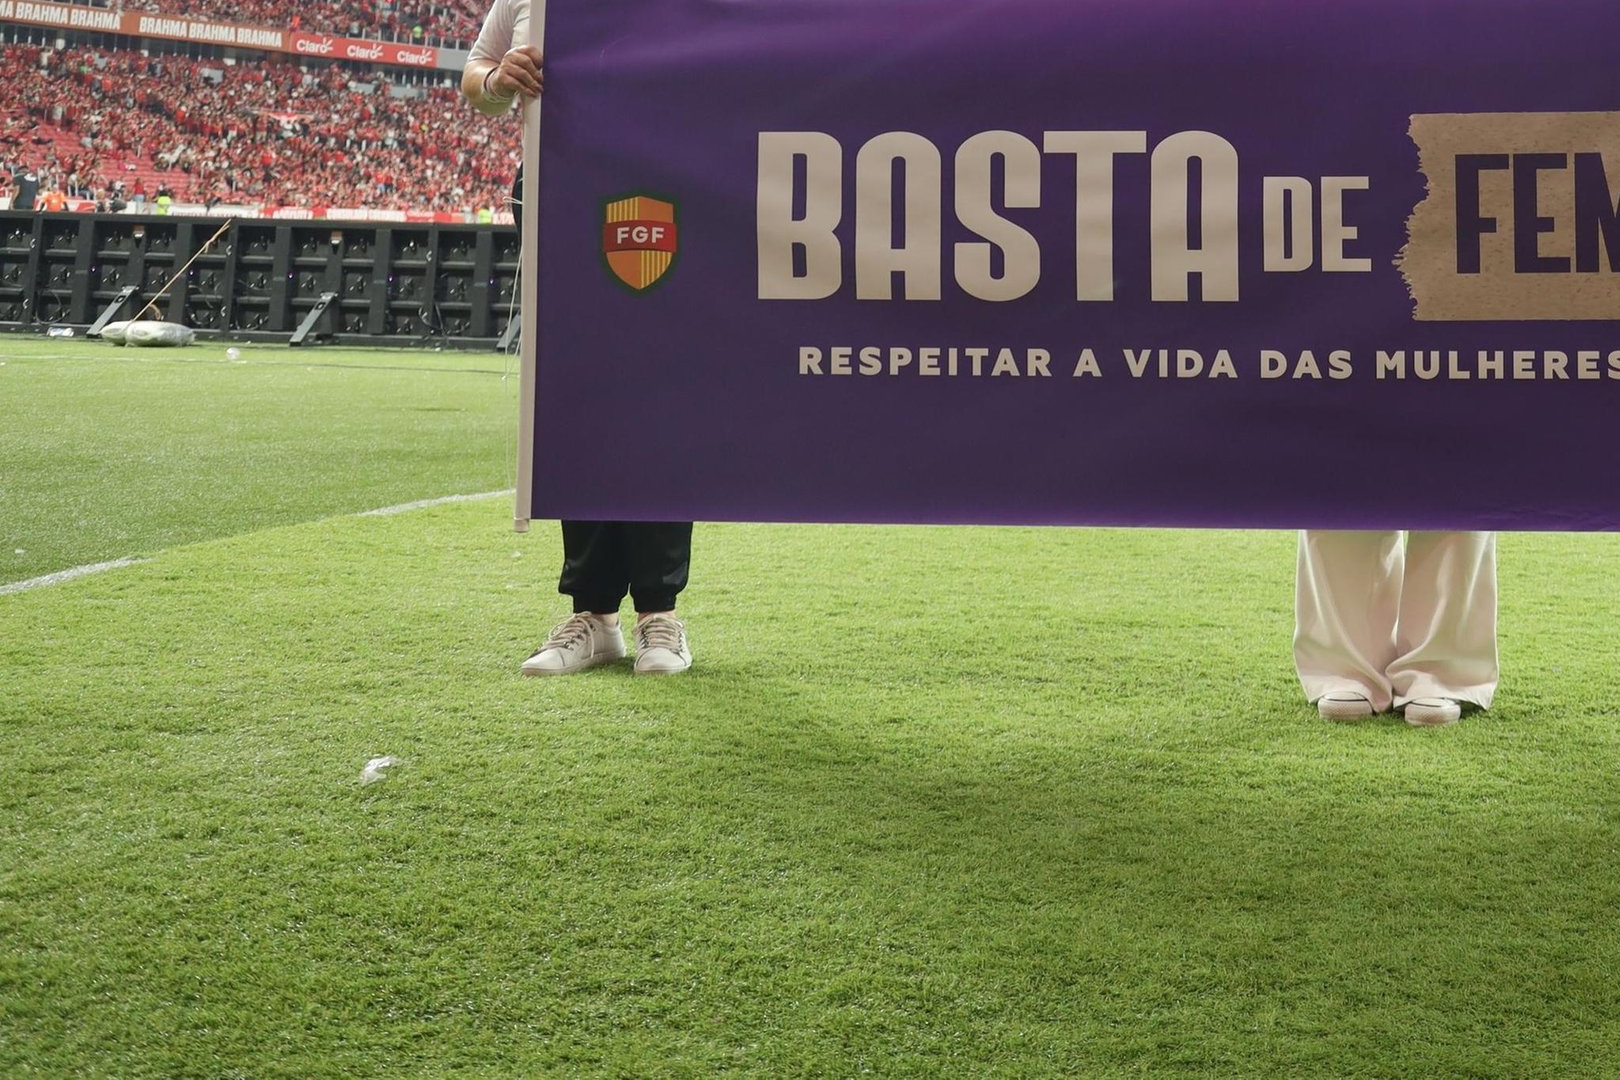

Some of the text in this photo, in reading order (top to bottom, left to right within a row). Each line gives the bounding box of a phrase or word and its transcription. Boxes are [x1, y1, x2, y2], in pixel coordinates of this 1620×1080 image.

[15, 2, 68, 25] BRAHMA
[70, 11, 121, 31] BRAHMA
[139, 16, 282, 48] BRAHMA BRAHMA BRAHMA
[296, 38, 430, 65] Claro Claro Claro
[757, 130, 1239, 302] BASTA
[1263, 176, 1372, 272] DE
[617, 226, 665, 244] FGF
[799, 346, 1052, 377] RESPEITAR
[1073, 348, 1103, 377] A
[1123, 349, 1238, 378] VIDA
[1260, 350, 1353, 379] DAS
